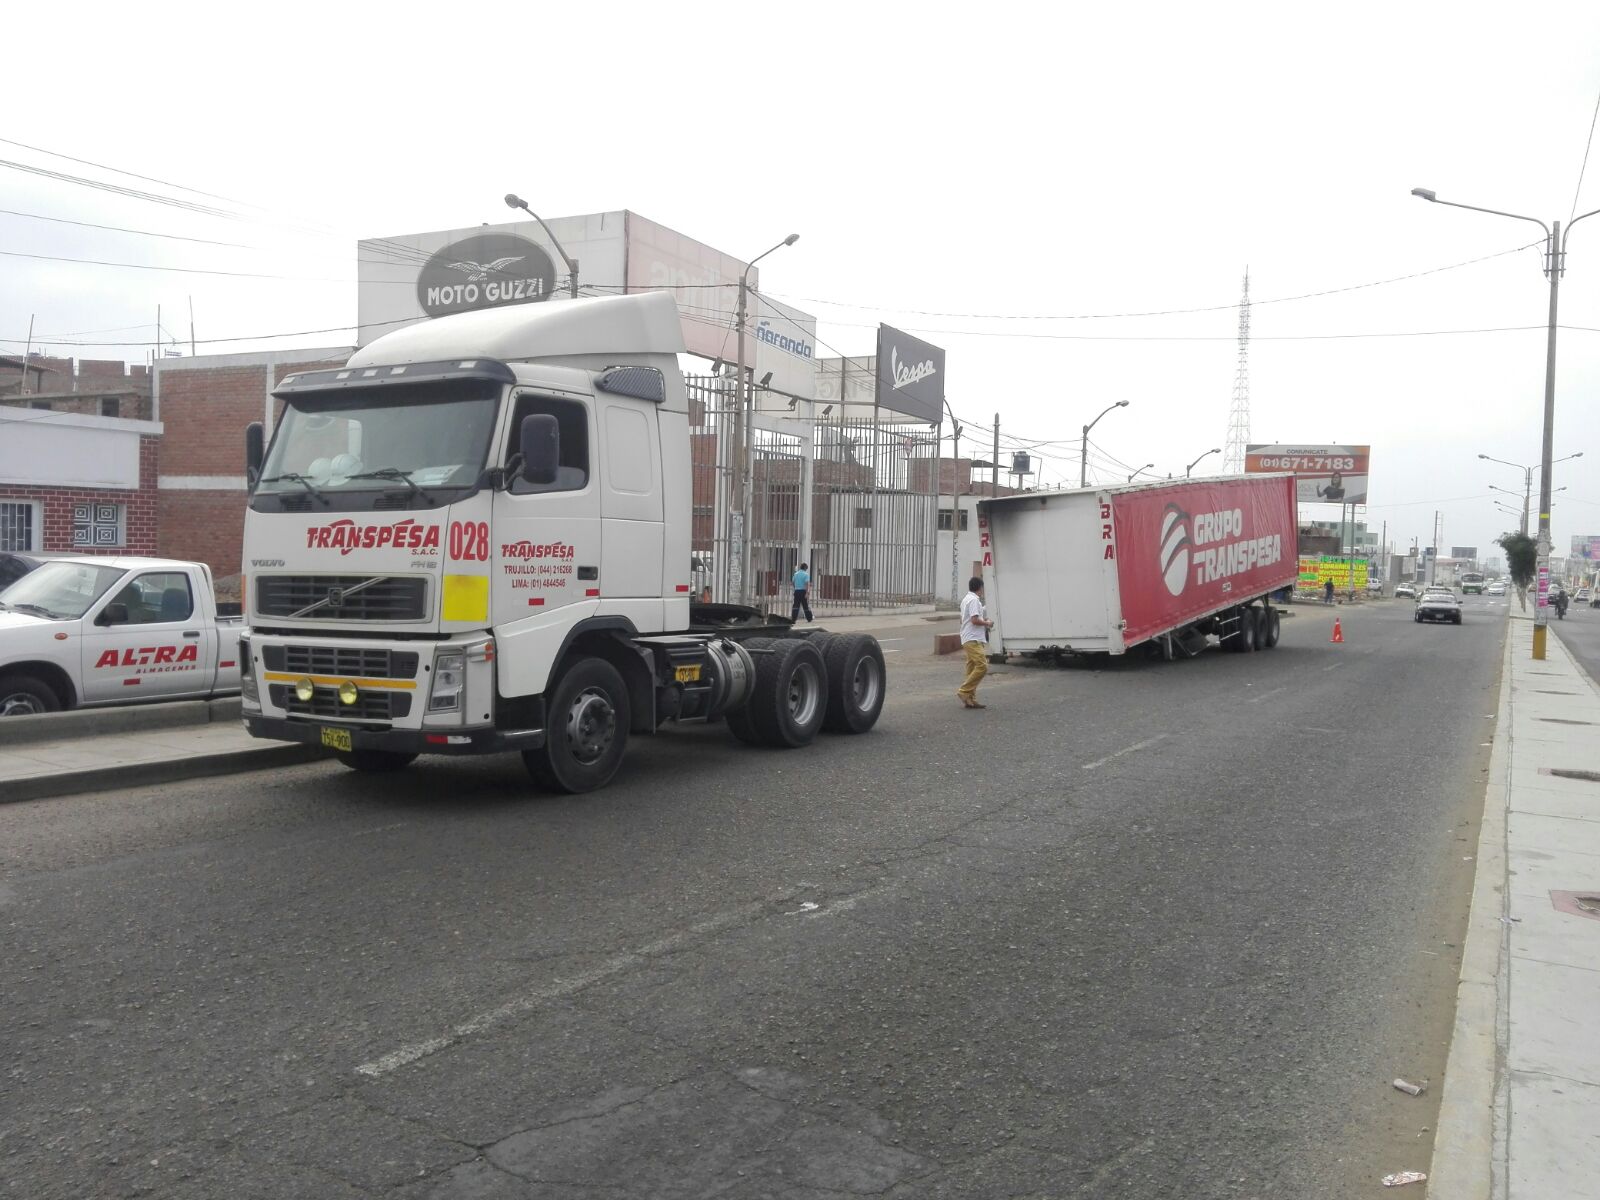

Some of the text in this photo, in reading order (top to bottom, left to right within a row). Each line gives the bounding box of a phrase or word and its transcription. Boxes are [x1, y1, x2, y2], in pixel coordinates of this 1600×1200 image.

[427, 278, 543, 306] MOTO GUZZI
[891, 345, 936, 390] Vespa
[307, 519, 440, 554] TRANSPESA
[450, 521, 489, 561] 028
[1194, 508, 1242, 545] GRUPO
[251, 559, 285, 568] VOLVO
[501, 541, 574, 560] TRANSPESA
[1193, 534, 1281, 585] TRANSPESA
[531, 579, 542, 589] (01)
[95, 645, 198, 668] ALTRA
